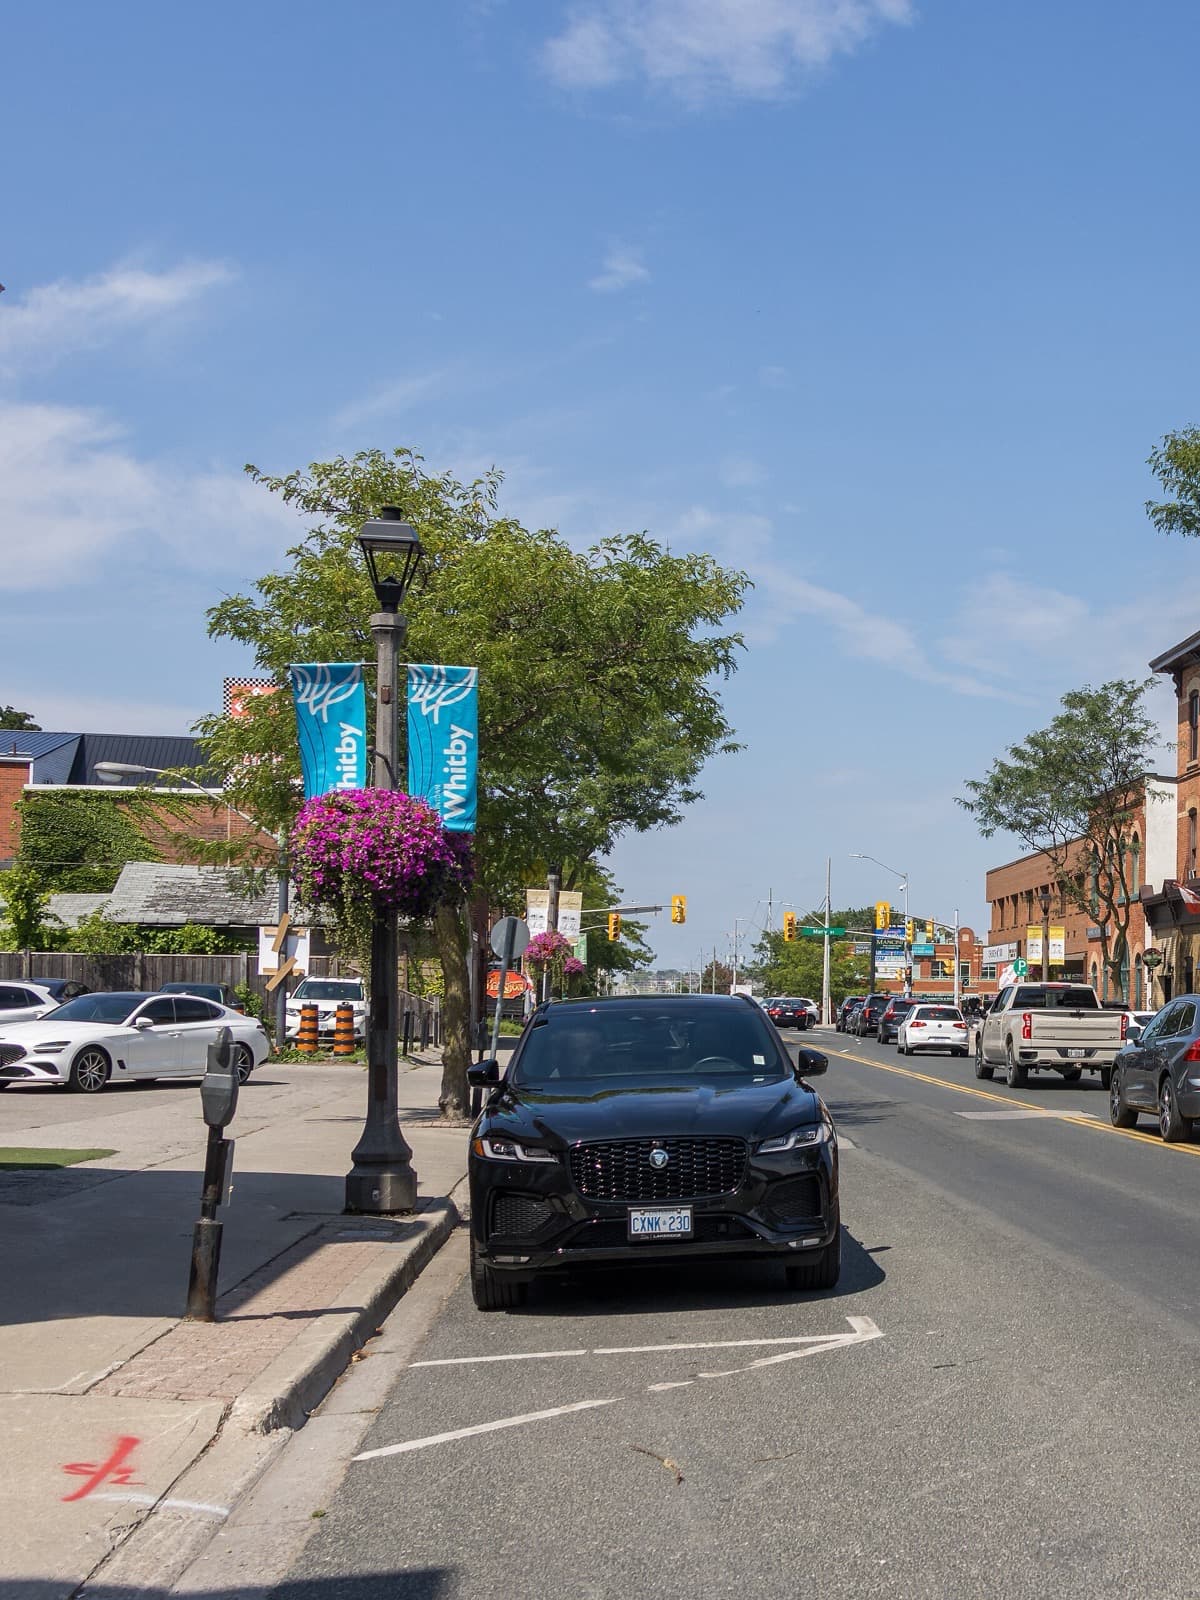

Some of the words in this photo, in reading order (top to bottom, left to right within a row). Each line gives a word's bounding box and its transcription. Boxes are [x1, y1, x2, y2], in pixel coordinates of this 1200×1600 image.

[335, 722, 362, 789] hitby
[443, 724, 474, 820] Whitby
[632, 1216, 661, 1232] CXNK
[668, 1215, 690, 1231] 230
